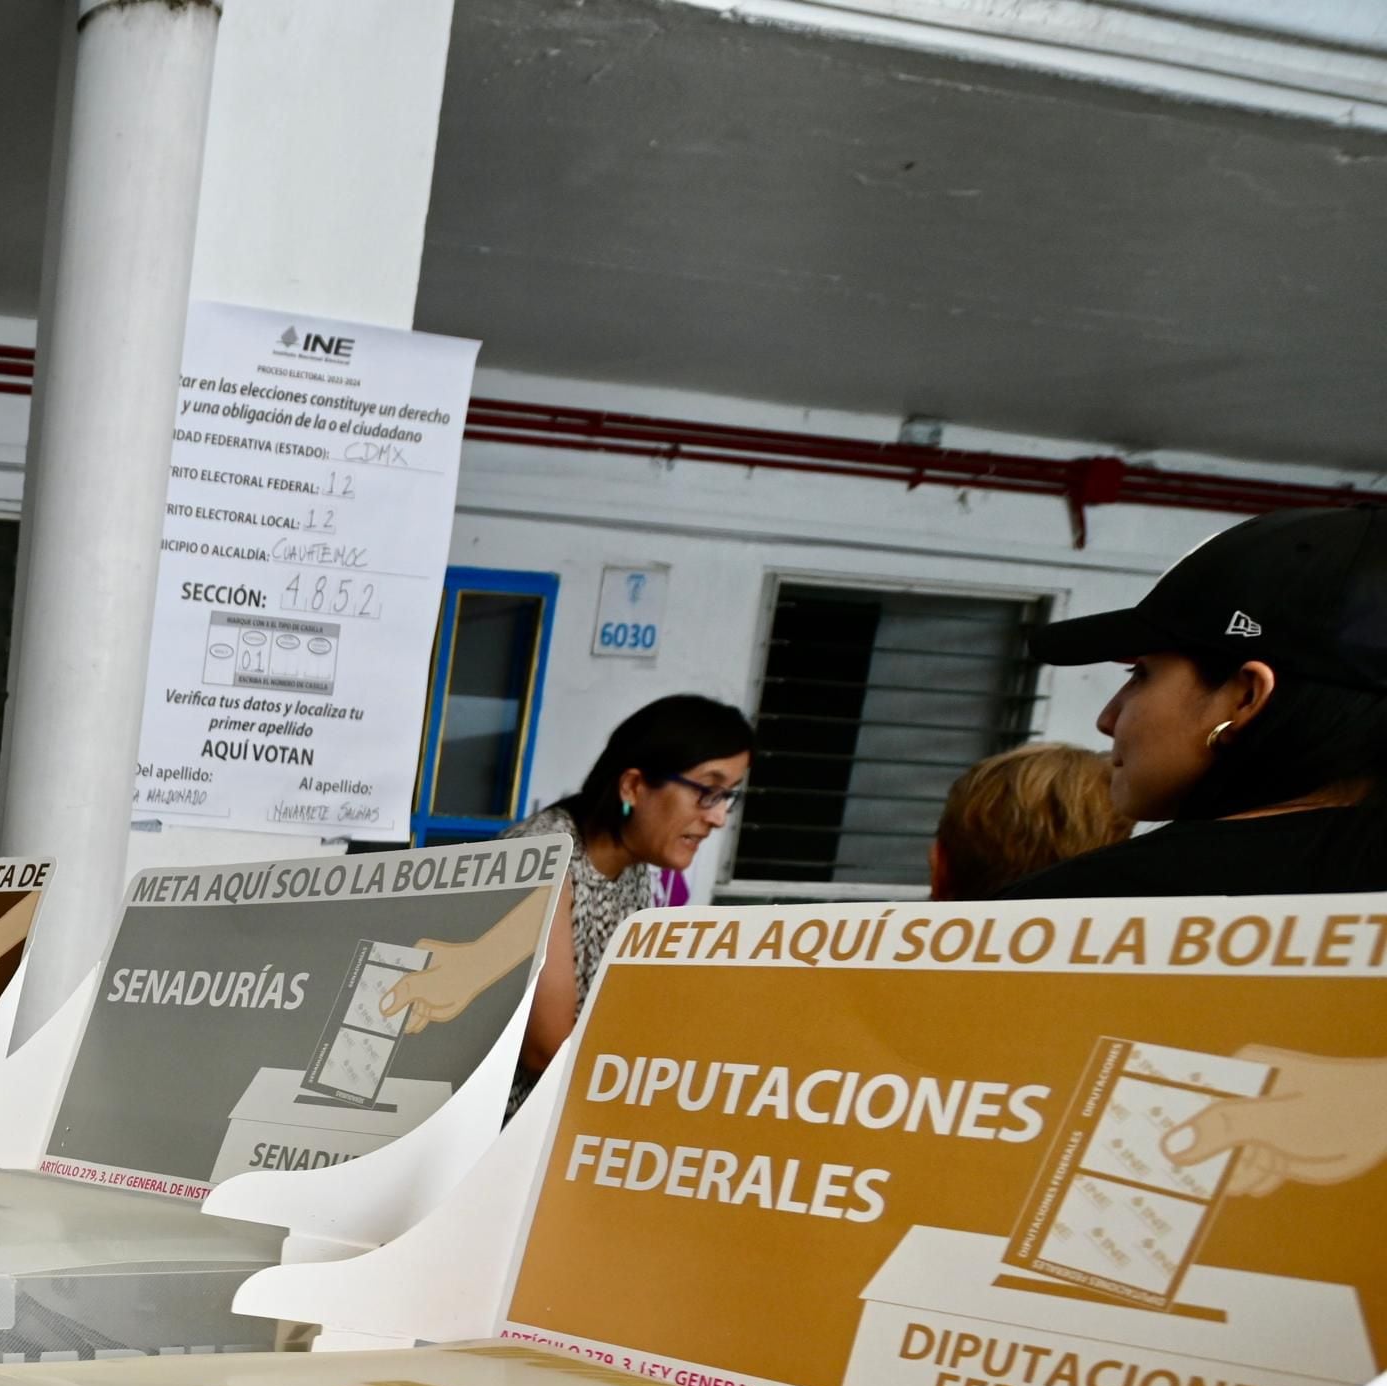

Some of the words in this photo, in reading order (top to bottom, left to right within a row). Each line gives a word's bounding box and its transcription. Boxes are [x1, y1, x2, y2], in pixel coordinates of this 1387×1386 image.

[301, 332, 356, 358] INE
[199, 377, 217, 393] en
[218, 374, 238, 396] las
[239, 380, 308, 406] elecciones
[310, 391, 377, 416] constituye
[379, 402, 396, 419] un
[398, 401, 451, 426] derecho
[192, 401, 220, 416] una
[222, 402, 293, 426] obligación
[294, 410, 312, 428] de
[313, 411, 327, 430] la
[339, 417, 352, 435] el
[352, 419, 423, 443] ciudadano
[204, 432, 276, 453] FEDERATIVA
[275, 441, 330, 461] (ESTADO):
[200, 466, 265, 489] ELECTORAL
[266, 478, 320, 495] FEDERAL:
[195, 505, 258, 526] ELECTORAL
[260, 514, 301, 531] LOCAL:
[211, 543, 270, 563] ALCALDÍA:
[180, 580, 267, 609] SECCIÓN:
[285, 572, 375, 616] 4852
[599, 621, 657, 649] 6030
[165, 687, 216, 708] Verifica
[218, 693, 240, 709] tus
[243, 696, 282, 714] datos
[283, 702, 294, 717] y
[294, 698, 347, 720] localiza
[349, 704, 364, 721] tu
[208, 715, 257, 733] primer
[257, 718, 314, 738] apellido
[200, 737, 250, 761] AQUÍ
[252, 743, 315, 767] VOTAN
[155, 766, 214, 784] apellido:
[298, 776, 314, 791] Al
[315, 778, 374, 797] apellido:
[17, 862, 50, 888] DE
[132, 873, 202, 904] META
[203, 864, 276, 906] AQUÍ
[272, 865, 349, 901] SOLO
[350, 863, 385, 896] LA
[393, 850, 510, 894] BOLETA
[514, 843, 565, 885] DE
[615, 919, 741, 960] META
[750, 908, 898, 969] AQUÍ
[893, 917, 1055, 965] SOLO
[1068, 917, 1146, 965] LA
[106, 963, 312, 1012] SENADURÍAS
[1082, 1042, 1124, 1118] DIPUTACIONES
[584, 1053, 1052, 1145] DIPUTACIONES
[39, 1159, 80, 1177] ARTÍCULO
[79, 1167, 98, 1181] 279,
[108, 1172, 127, 1186] LEY
[126, 1175, 168, 1194] GENERAL
[169, 1182, 184, 1196] DE
[564, 1133, 892, 1224] FEDERALES
[1018, 1185, 1058, 1259] DIPUTACIONES
[1054, 1130, 1084, 1189] FEDERALES
